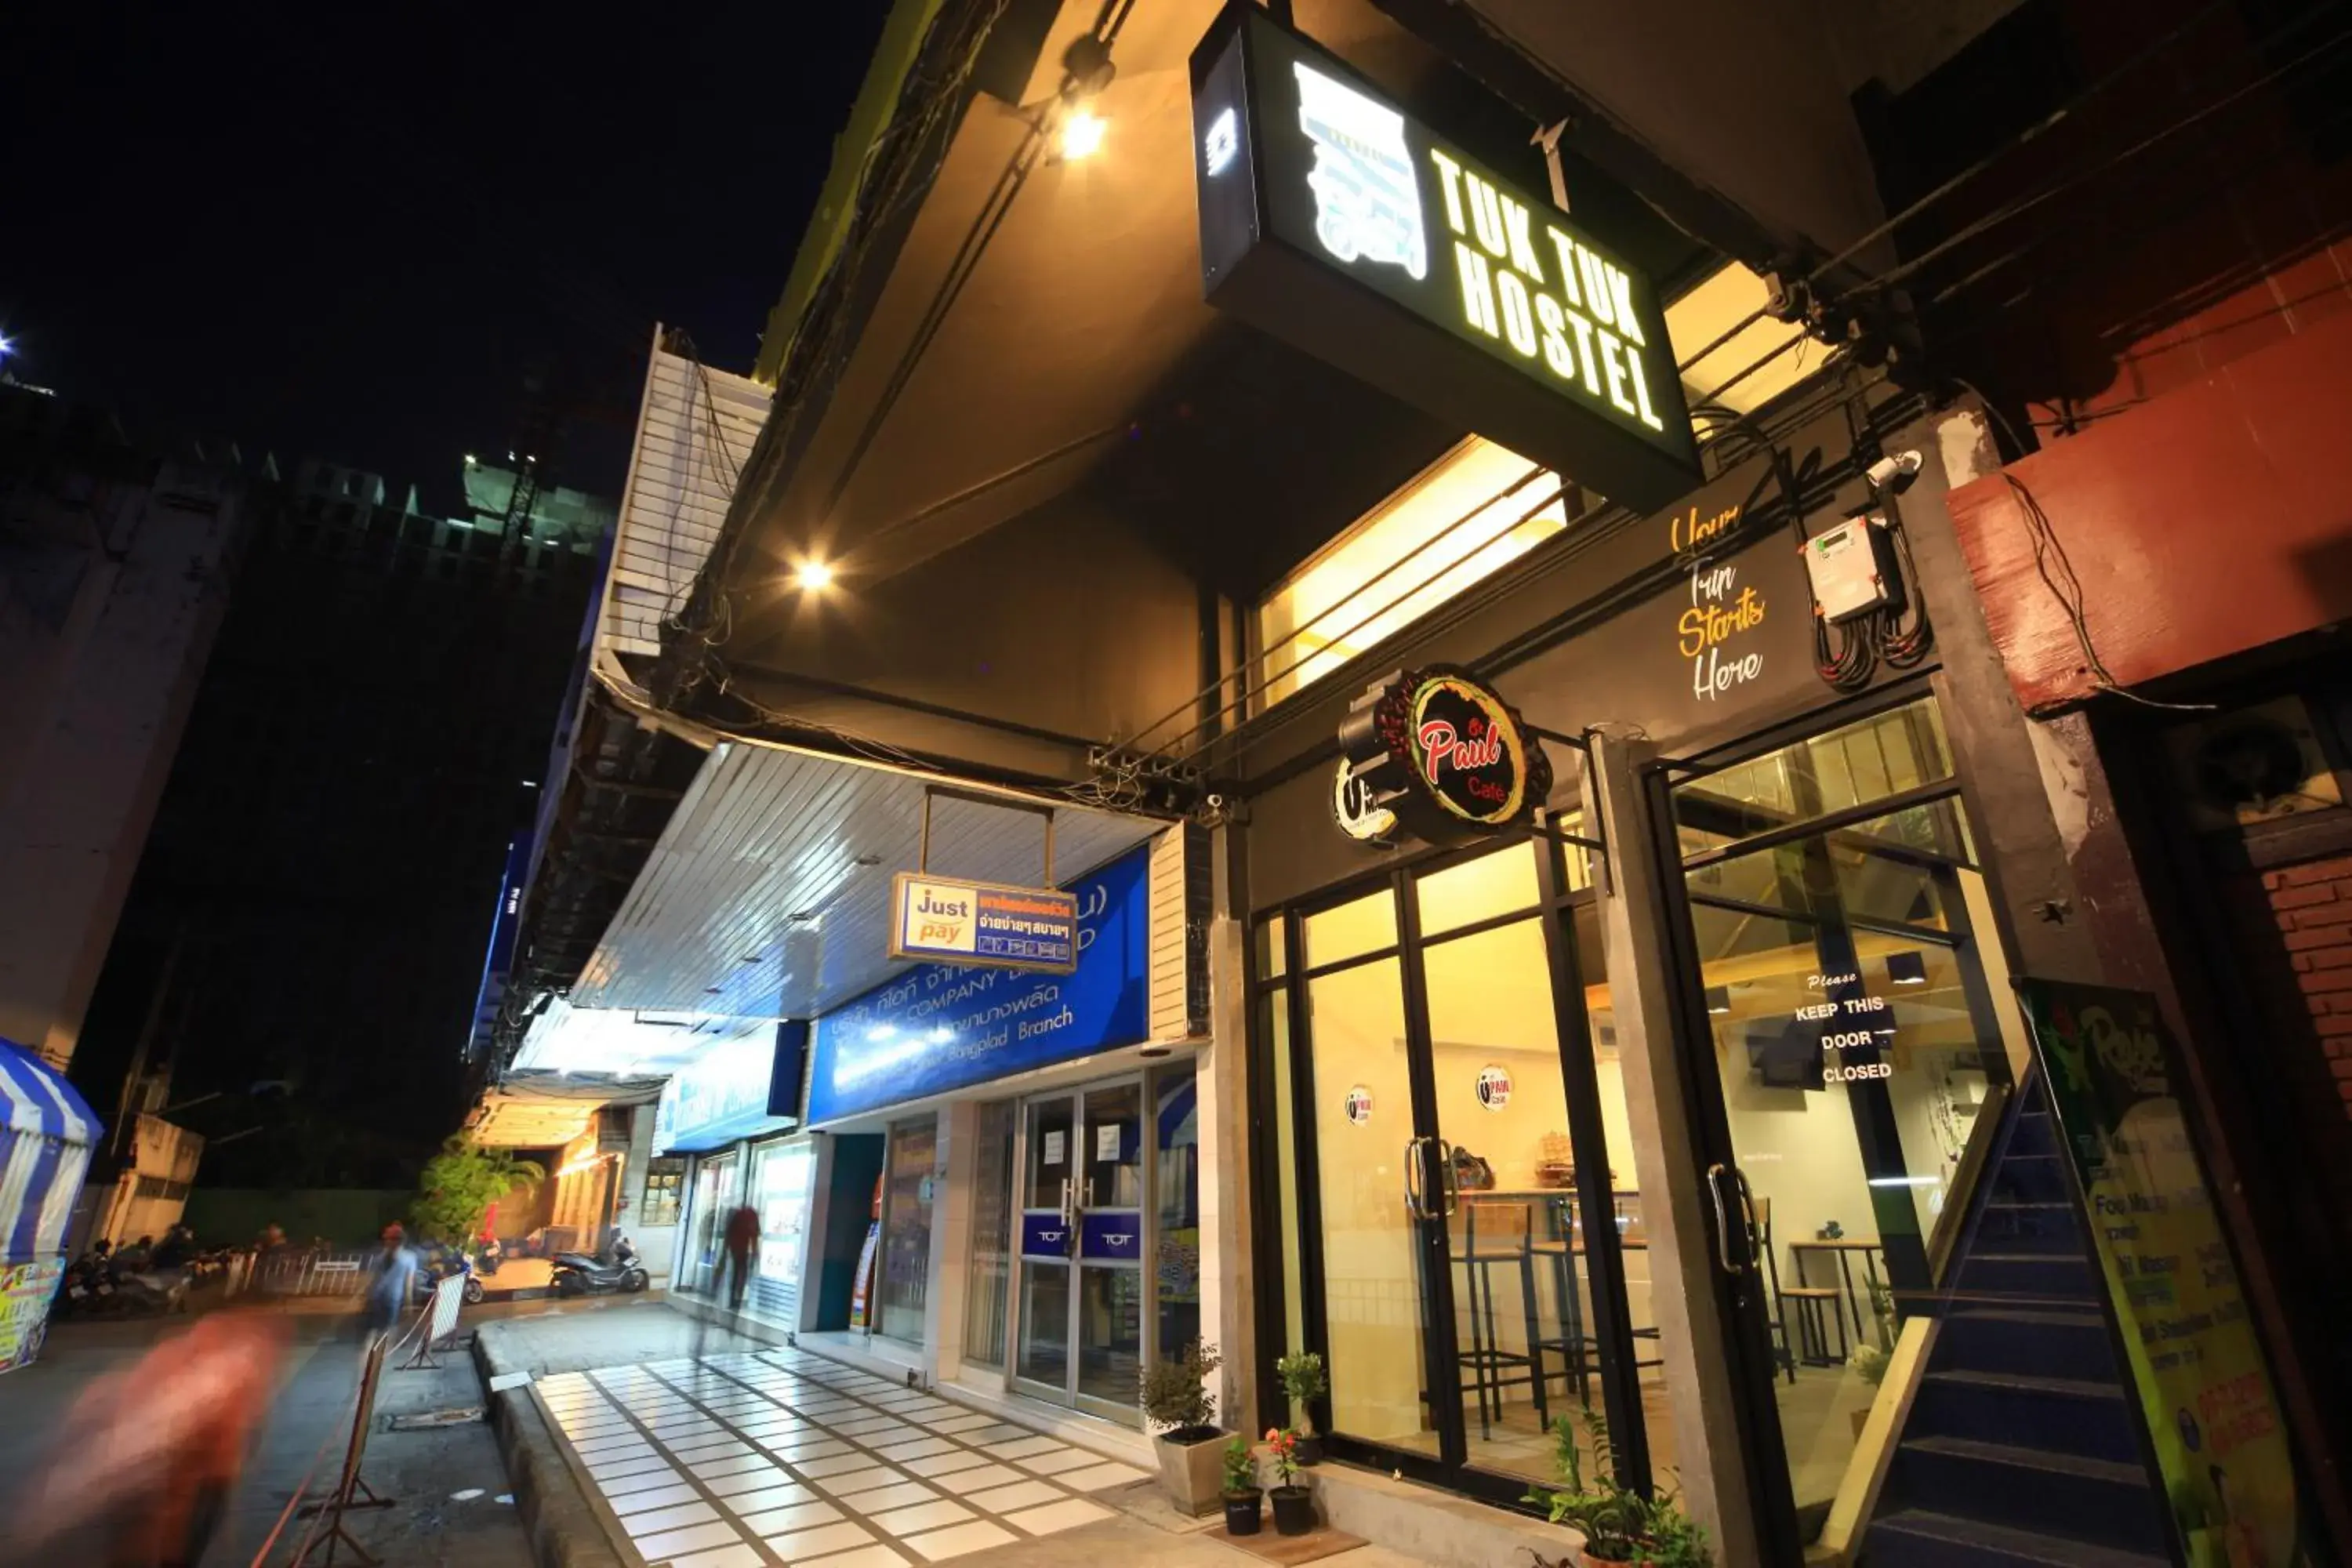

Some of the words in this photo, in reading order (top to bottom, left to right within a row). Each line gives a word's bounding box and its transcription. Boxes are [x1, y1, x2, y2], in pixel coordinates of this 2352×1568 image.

[1431, 147, 1544, 284] TUK
[1547, 225, 1646, 347] TUK
[1454, 241, 1664, 432] HOSTEL
[1679, 586, 1766, 657] Starts
[1693, 647, 1763, 701] Here
[1418, 720, 1501, 784] Paul
[917, 890, 968, 917] just
[920, 924, 960, 944] pay
[907, 969, 998, 1019] COMPANY
[1807, 973, 1857, 989] Please
[1018, 1004, 1073, 1040] Branch
[1795, 1003, 1838, 1021] KEEP
[1844, 996, 1884, 1014] THIS
[1821, 1031, 1872, 1049] DOOR
[1823, 1063, 1892, 1082] CLOSED
[1038, 1231, 1065, 1242] TOT
[1102, 1234, 1134, 1245] TOT
